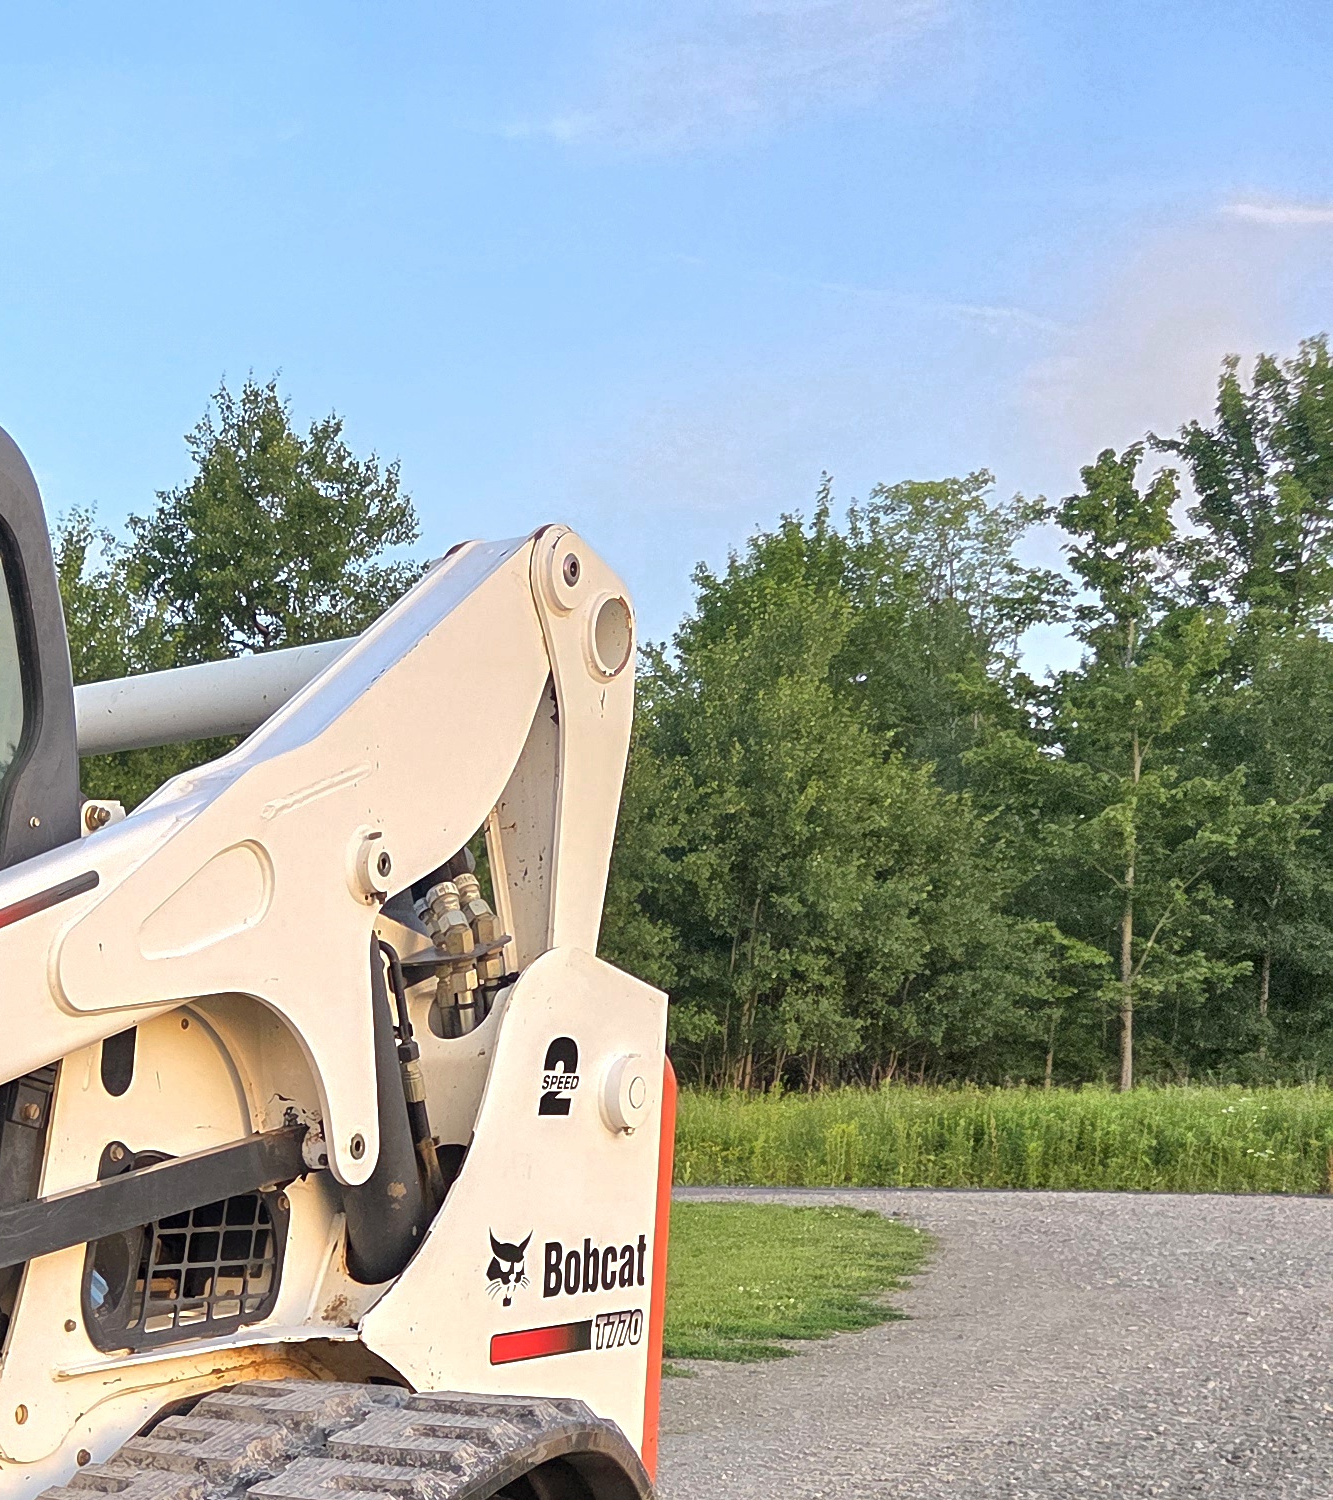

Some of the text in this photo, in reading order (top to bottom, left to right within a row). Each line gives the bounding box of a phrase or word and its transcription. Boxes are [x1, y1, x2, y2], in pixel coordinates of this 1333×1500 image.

[538, 1036, 579, 1116] 2
[541, 1074, 580, 1091] SPEED
[542, 1234, 647, 1299] Bobcat
[594, 1308, 644, 1351] T770
